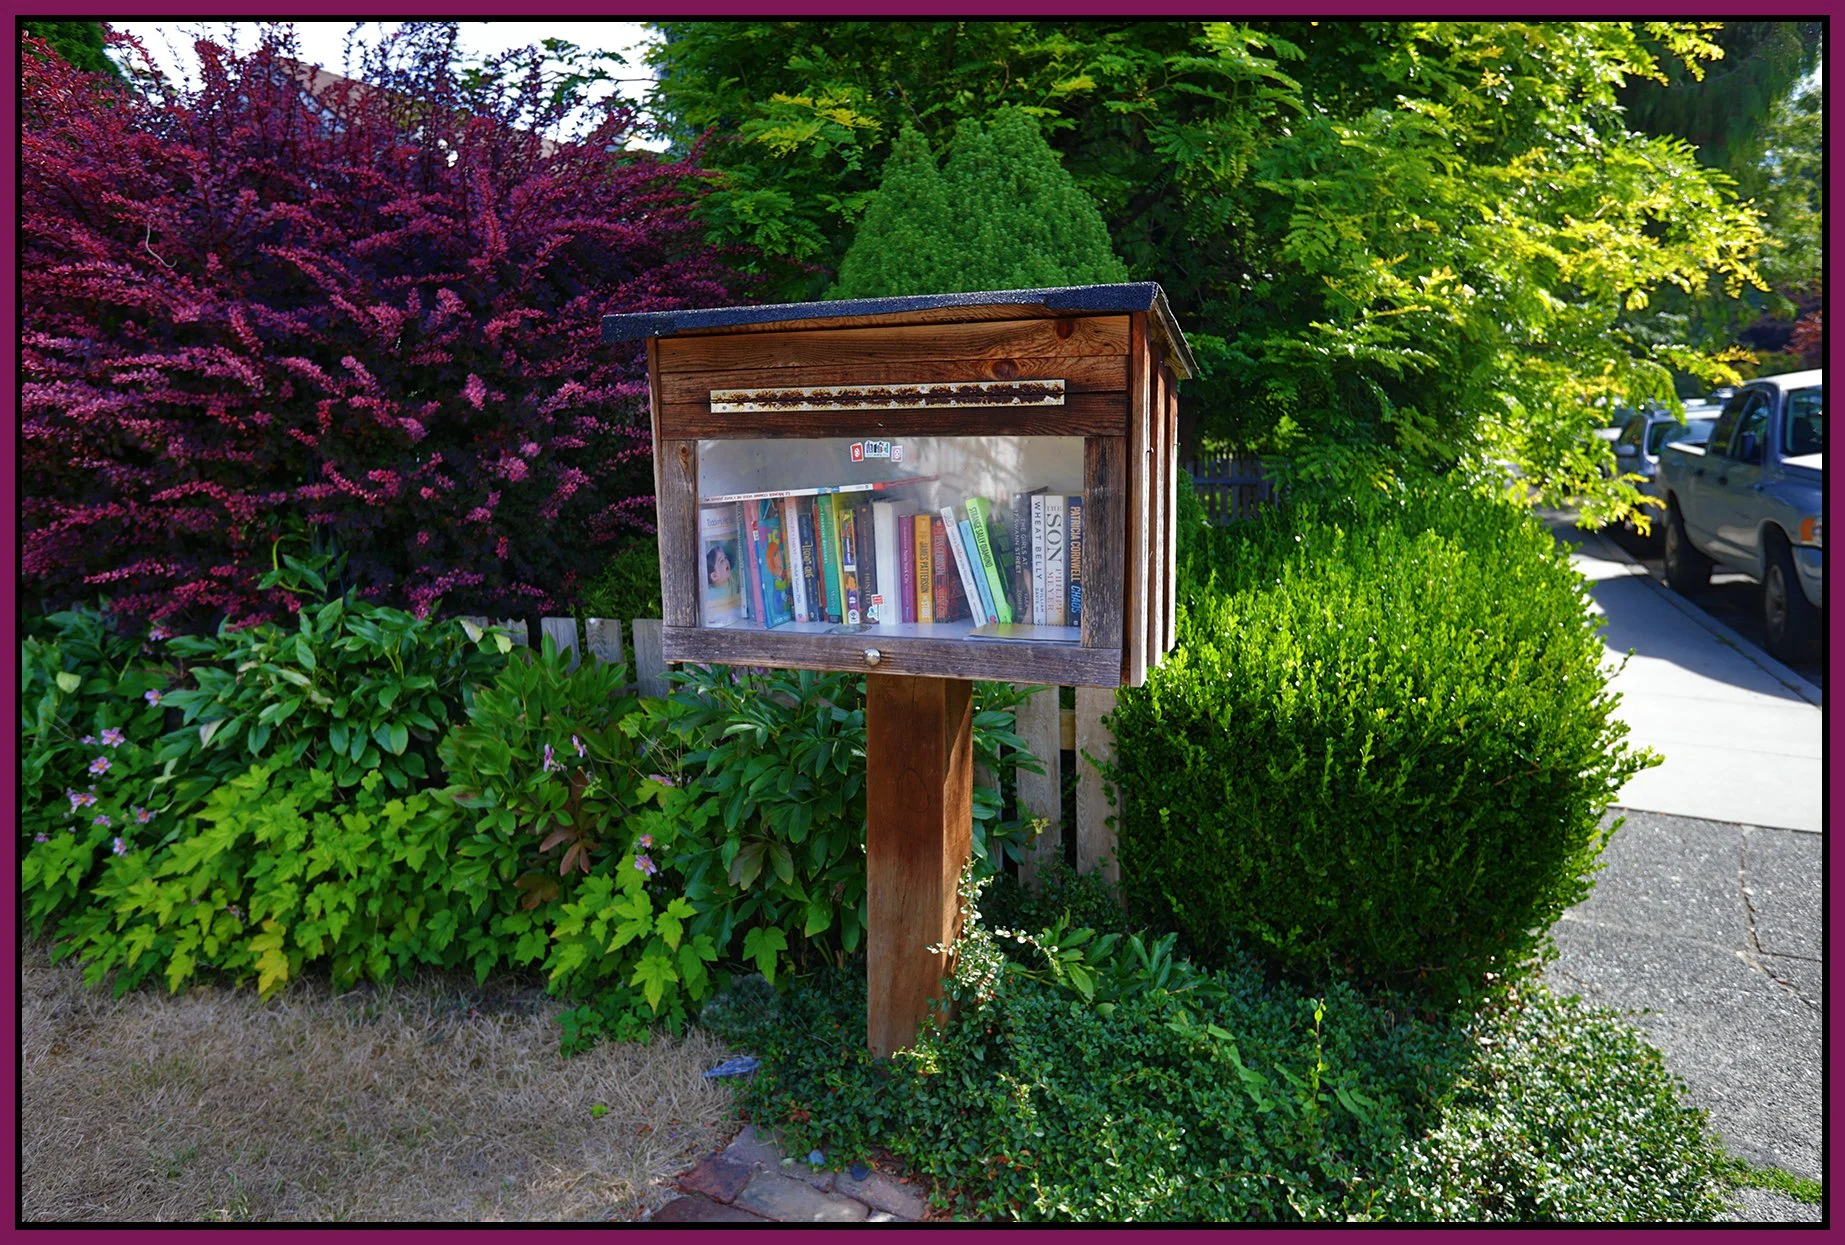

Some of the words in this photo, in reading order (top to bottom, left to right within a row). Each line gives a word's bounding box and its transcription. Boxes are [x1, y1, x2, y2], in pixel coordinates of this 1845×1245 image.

[968, 506, 982, 529] STRANGE
[1070, 506, 1081, 540] PATRICIA
[974, 529, 987, 544] SALLY
[1020, 534, 1028, 556] GIRLS
[1046, 513, 1063, 563] SON
[919, 541, 929, 560] JAMES
[979, 544, 993, 568] DIAMOND
[1022, 556, 1028, 566] AT
[1035, 546, 1043, 580] BELLY
[1070, 541, 1081, 582] CORNWELL
[919, 561, 930, 593] PATTERSON
[1070, 585, 1081, 614] CHAOS
